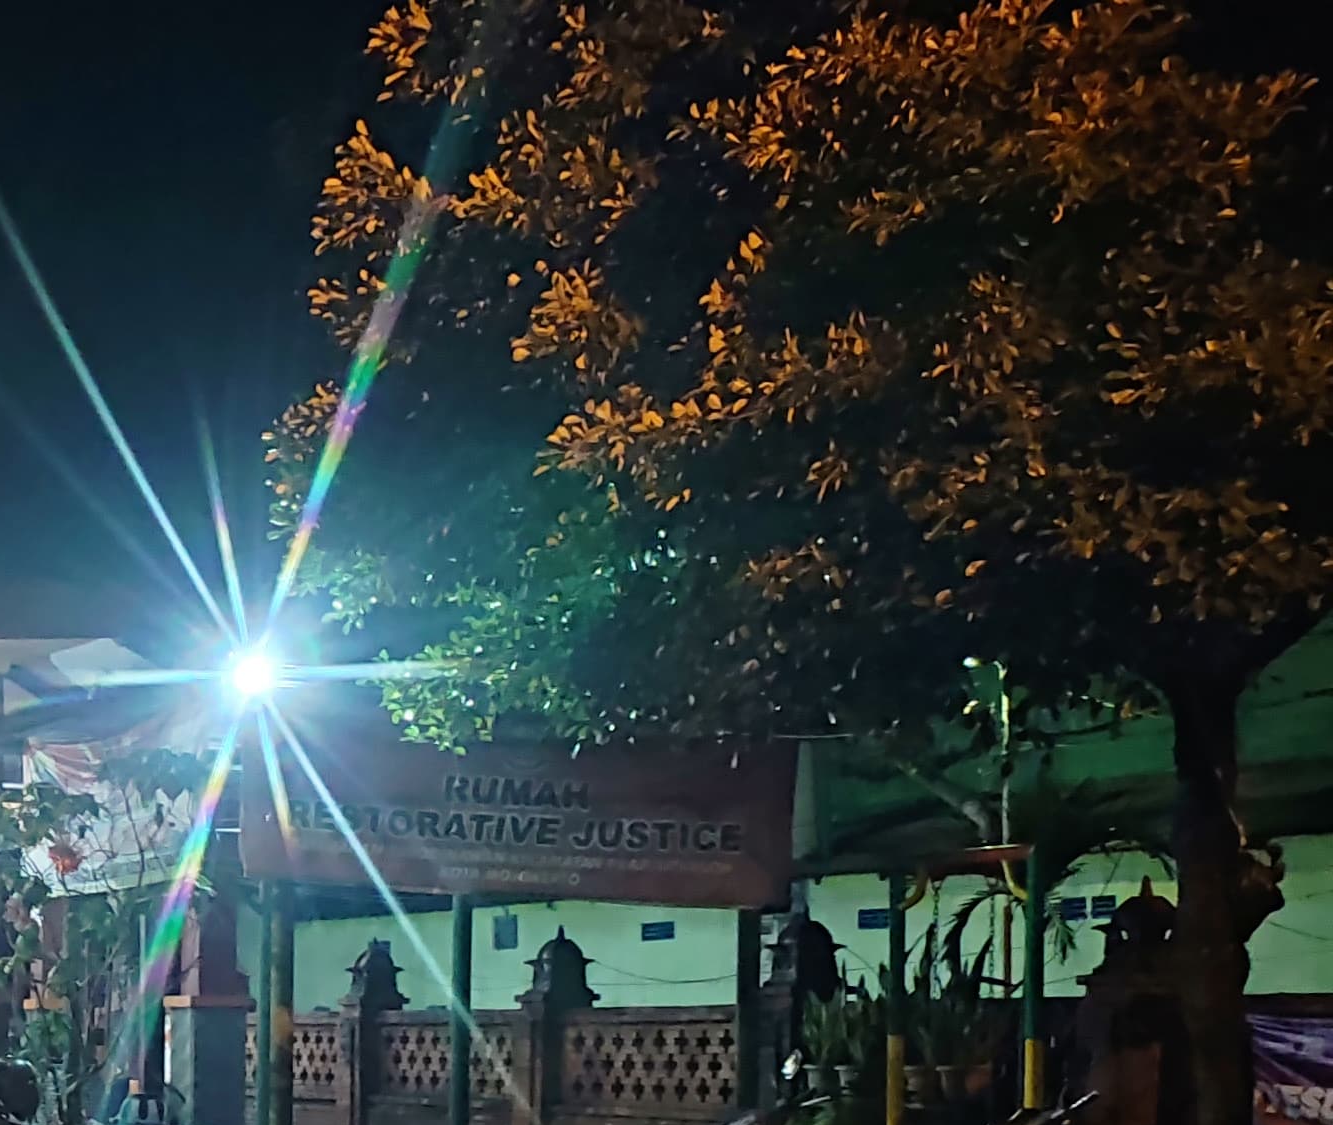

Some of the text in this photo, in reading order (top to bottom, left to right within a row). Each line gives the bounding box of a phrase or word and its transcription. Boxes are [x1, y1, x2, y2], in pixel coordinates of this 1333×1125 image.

[445, 775, 590, 810] RUMAH
[289, 801, 562, 847] RESTORATIVE
[571, 819, 744, 852] JUSTICE
